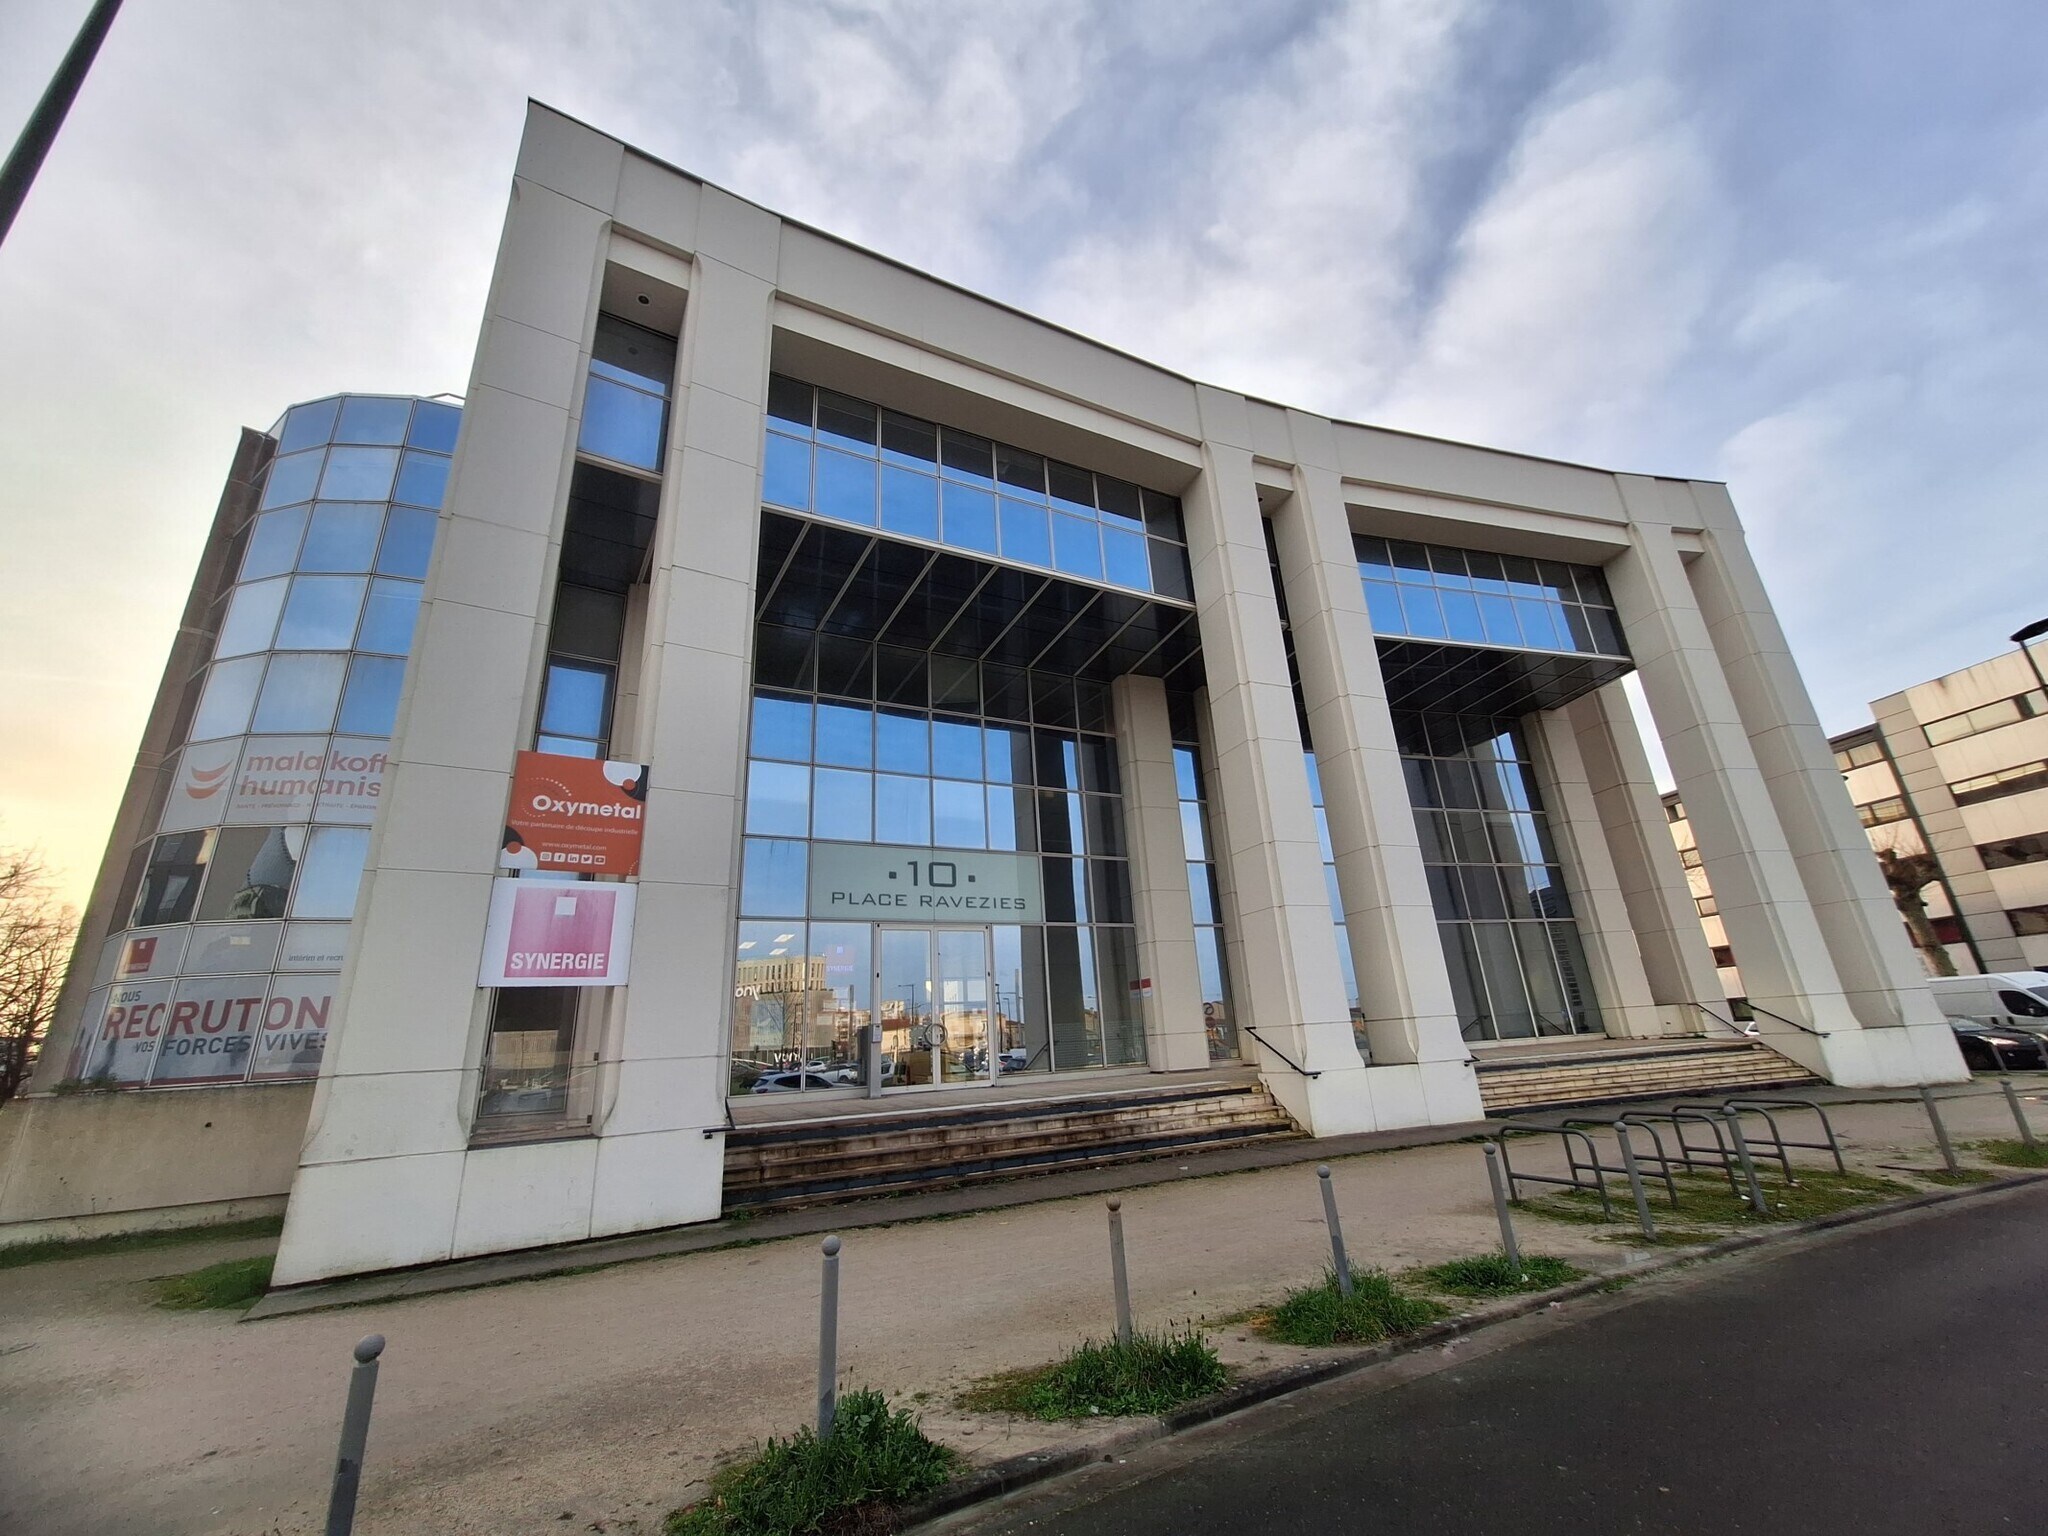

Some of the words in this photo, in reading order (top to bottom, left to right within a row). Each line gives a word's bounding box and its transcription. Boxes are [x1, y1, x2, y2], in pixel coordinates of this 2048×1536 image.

[239, 775, 382, 797] humanis
[532, 794, 642, 819] Oxymetal
[530, 821, 565, 831] partenaire
[541, 842, 607, 852] www.oxymetal.com
[831, 892, 908, 907] PLACE
[919, 895, 1026, 910] RAVEZIES
[511, 952, 605, 971] SYNERGIE
[102, 996, 331, 1041] RECRUTON
[134, 1041, 156, 1053] VOS
[161, 1035, 252, 1056] FORCES
